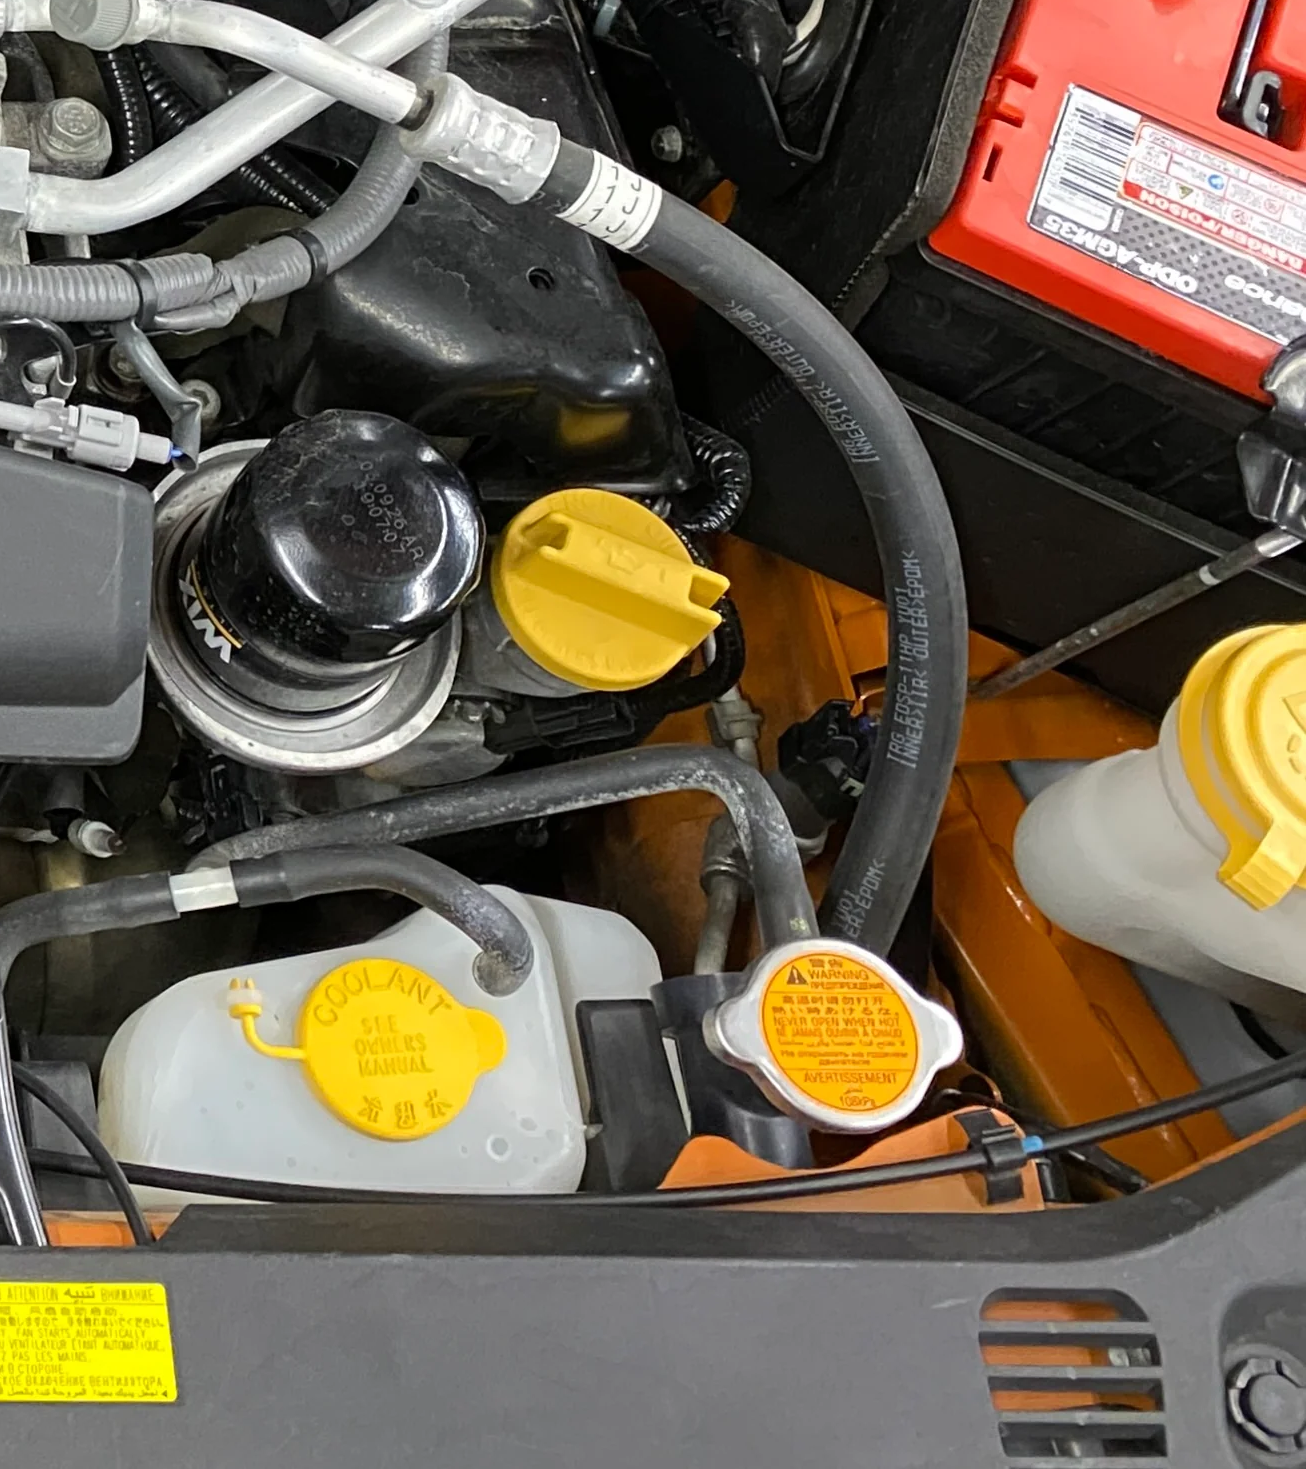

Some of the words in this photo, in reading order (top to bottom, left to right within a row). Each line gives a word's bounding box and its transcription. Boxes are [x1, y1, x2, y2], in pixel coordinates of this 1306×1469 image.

[1139, 189, 1304, 271] DANGER/POISON
[1042, 213, 1198, 294] ODP-AGM35
[1224, 273, 1306, 325] ance
[179, 566, 231, 664] WIX
[808, 969, 869, 981] WARNING
[313, 967, 453, 1027] COOLANT
[360, 1014, 399, 1035] SEE
[773, 1017, 807, 1027] NEVER
[811, 1017, 840, 1027] OPEN
[842, 1017, 875, 1027] WHEN
[879, 1017, 900, 1027] HOT
[792, 1029, 823, 1038] JAMAIS
[873, 1029, 902, 1039] CHAUD
[358, 1054, 434, 1078] MANUAL
[804, 1072, 897, 1085] AVERTISSEMENT
[7, 1287, 58, 1301] ATTENTION
[101, 1288, 155, 1302] ВНИМАНИЕ
[16, 1329, 33, 1339] FAN
[38, 1329, 71, 1339] STARTS
[9, 1339, 67, 1351] VENTILATEUR
[12, 1351, 31, 1362] PAS
[35, 1351, 53, 1362] LES
[25, 1375, 85, 1387] ВКЛЮЧЕНИЕ
